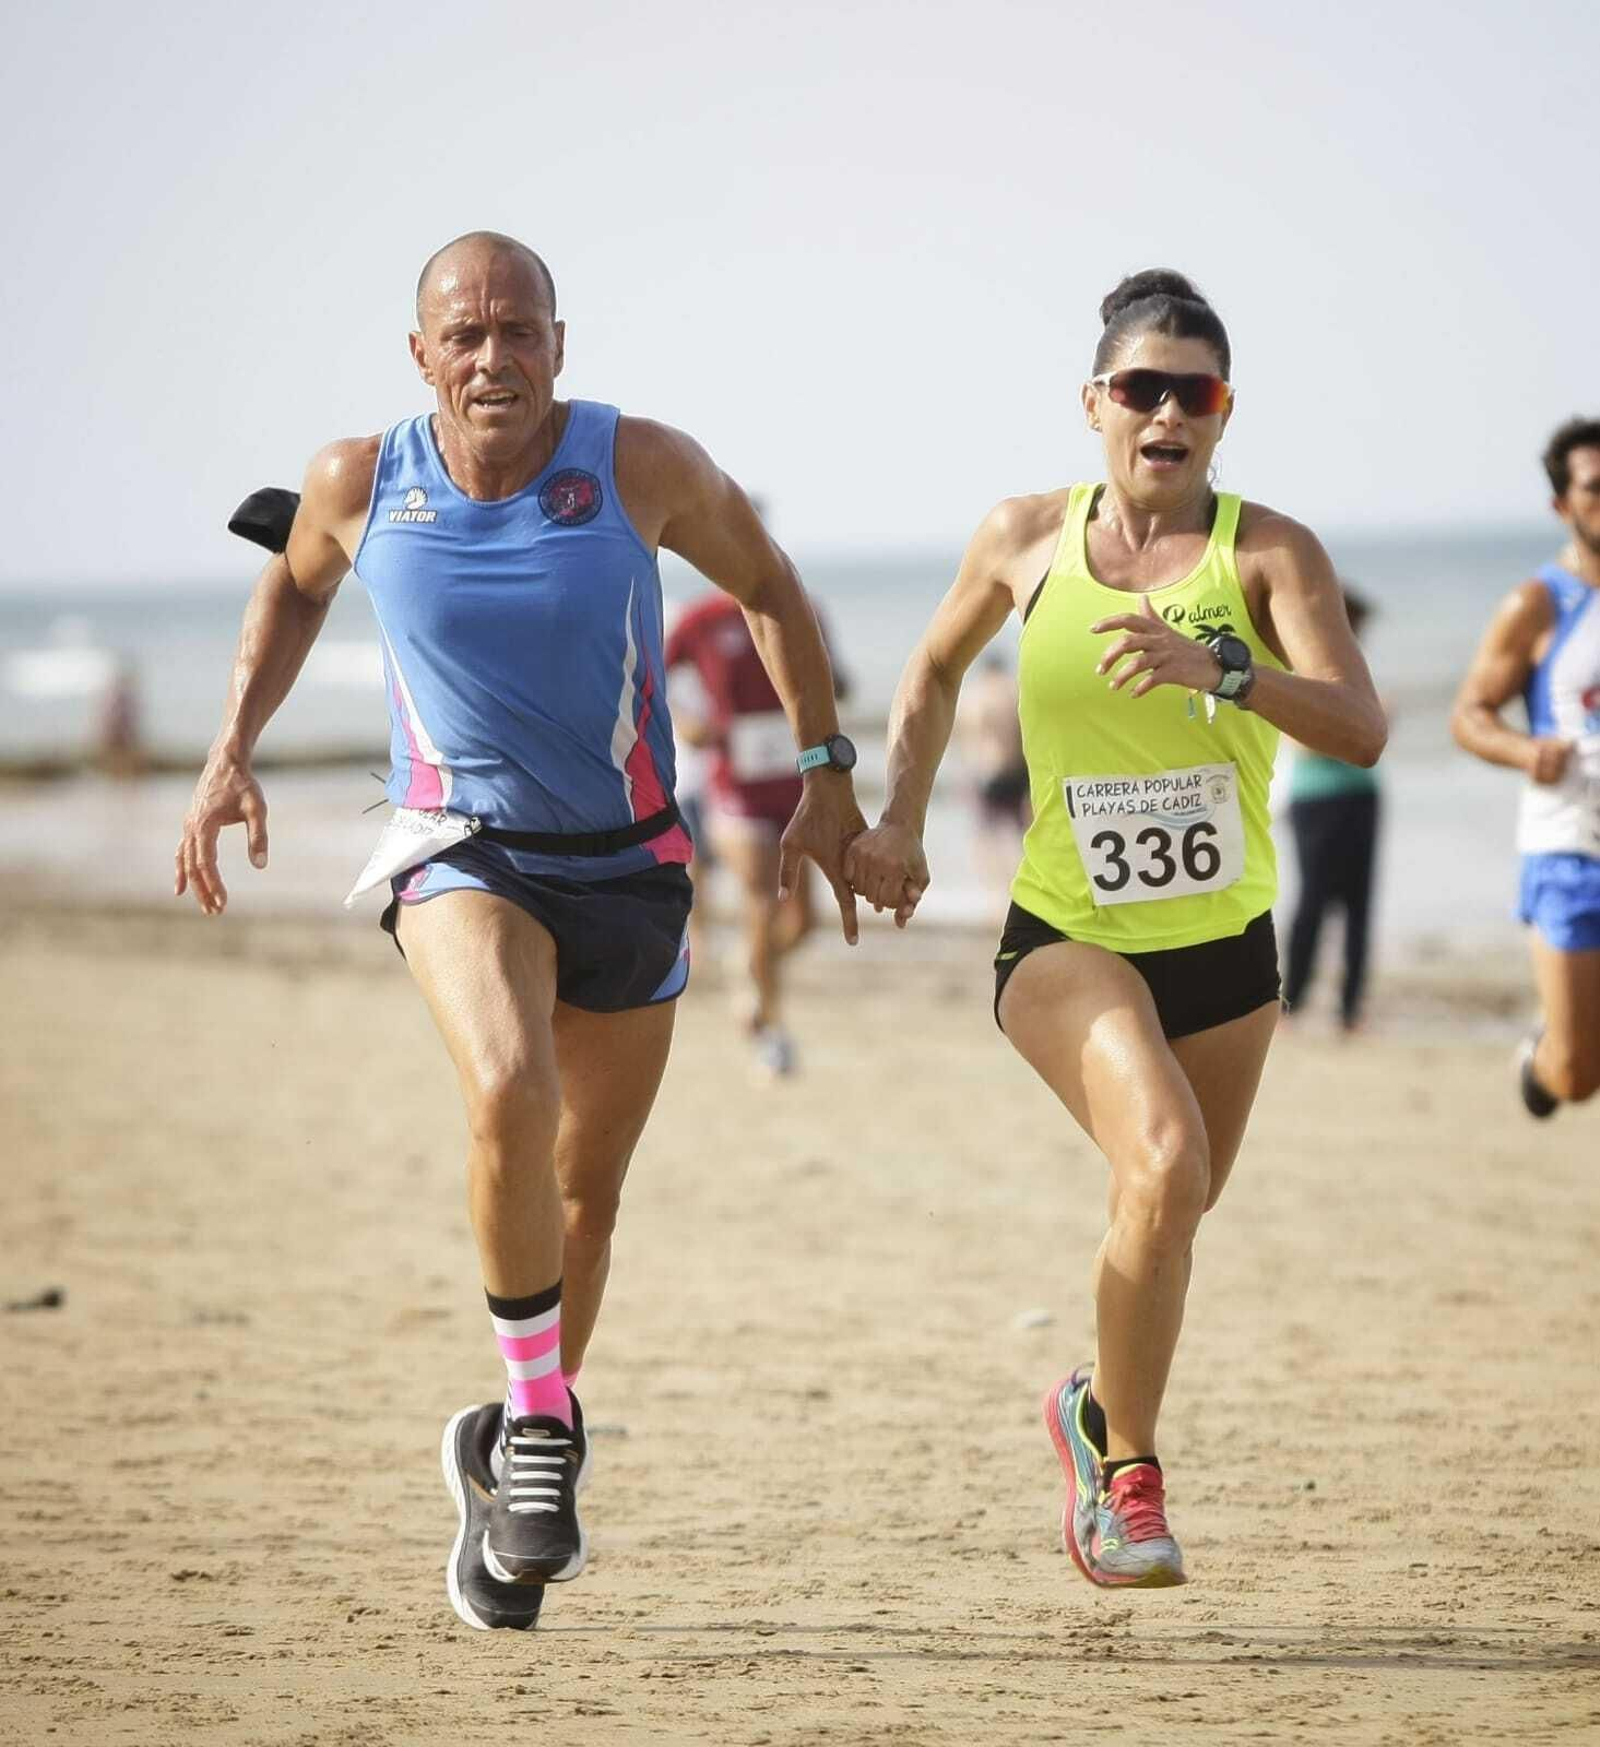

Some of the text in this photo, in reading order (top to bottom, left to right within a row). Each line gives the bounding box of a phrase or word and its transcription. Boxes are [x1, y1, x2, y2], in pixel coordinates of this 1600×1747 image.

[389, 510, 437, 523] VIATOR
[1162, 603, 1232, 624] Palmer
[1076, 781, 1140, 799] CARRERA
[1144, 774, 1202, 794] POPULAR
[1082, 799, 1136, 817] PLAYAS
[1140, 800, 1159, 813] DE
[1162, 793, 1202, 811] CADIZ
[1091, 821, 1221, 891] 336
